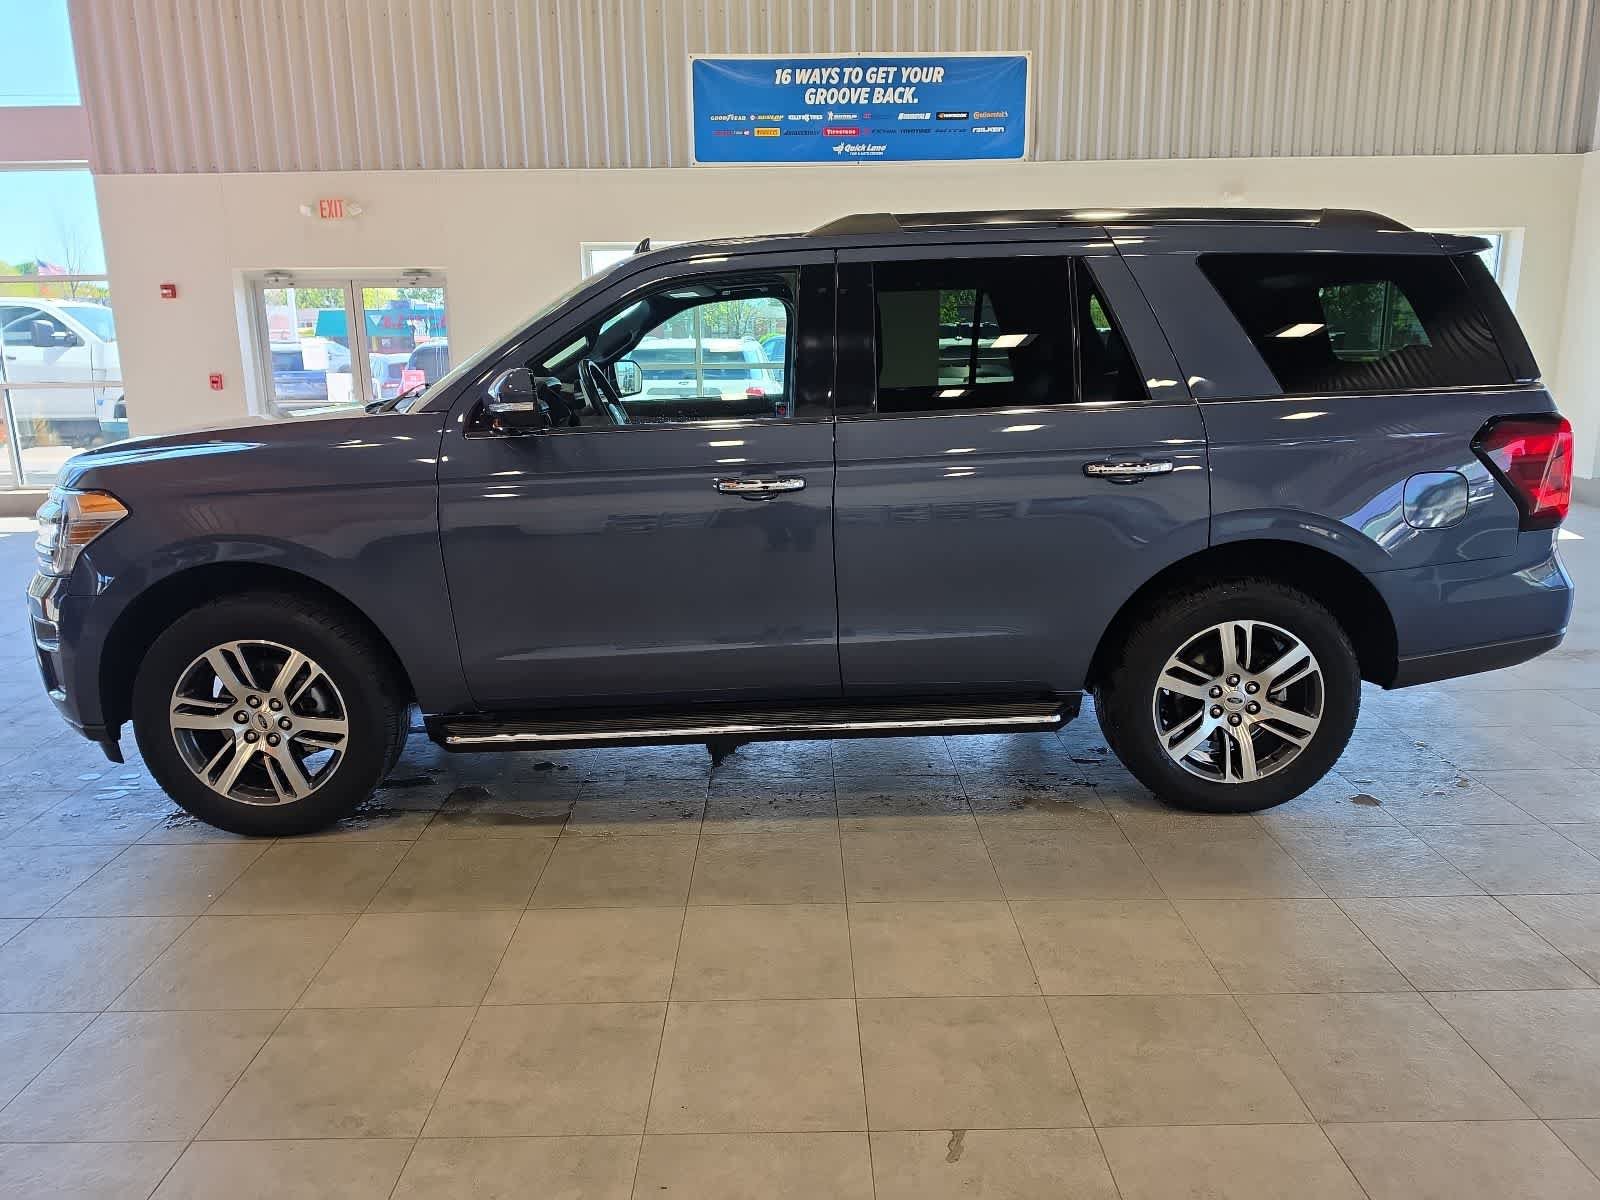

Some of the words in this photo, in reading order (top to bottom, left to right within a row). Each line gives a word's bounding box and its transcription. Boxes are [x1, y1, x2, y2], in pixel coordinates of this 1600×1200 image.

[775, 69, 792, 85] 16
[795, 68, 840, 85] WAYS
[843, 67, 863, 84] TO
[866, 67, 897, 84] GET
[901, 66, 945, 83] YOUR
[804, 88, 871, 105] GROOVE
[872, 87, 918, 104] BACK.
[844, 143, 866, 152] Quick
[866, 143, 887, 152] Lane
[319, 199, 344, 219] EXIT
